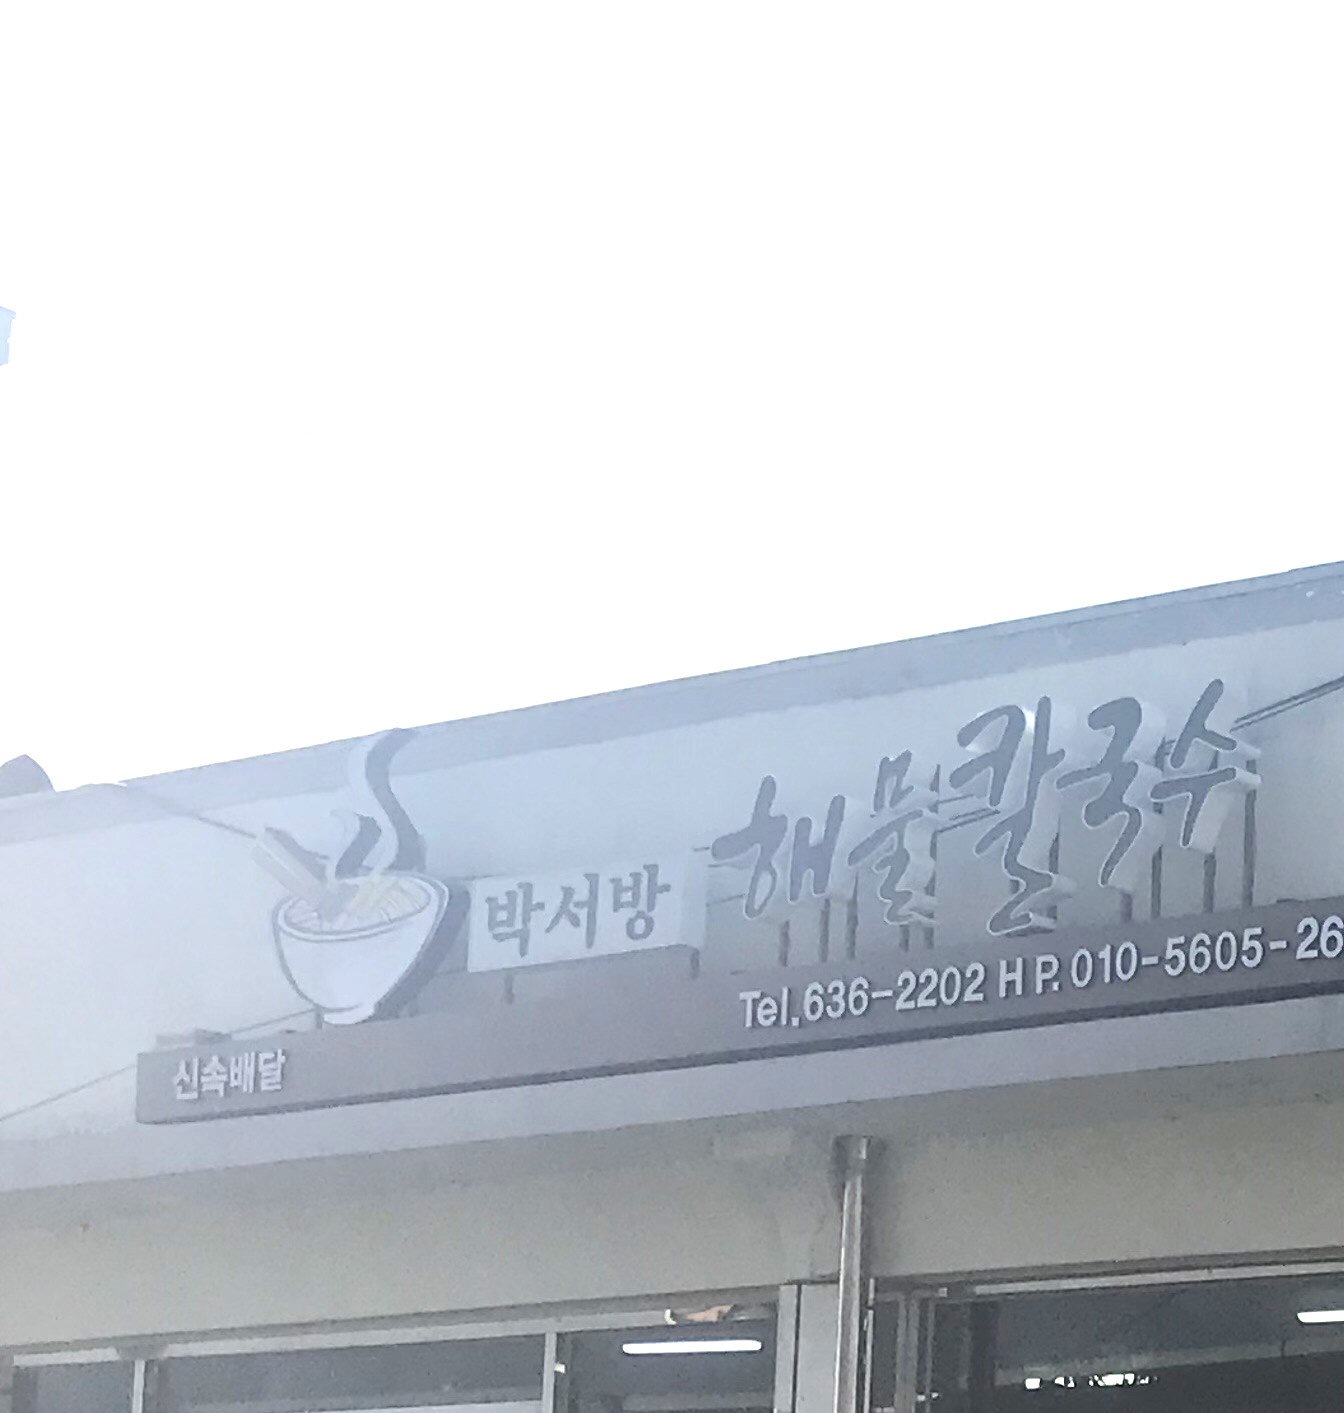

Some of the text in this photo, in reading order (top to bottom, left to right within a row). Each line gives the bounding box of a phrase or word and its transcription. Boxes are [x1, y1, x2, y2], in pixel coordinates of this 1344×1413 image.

[711, 679, 1240, 936] 해물칼국수
[487, 863, 671, 957] 박서방
[172, 1049, 287, 1101] 신속배달
